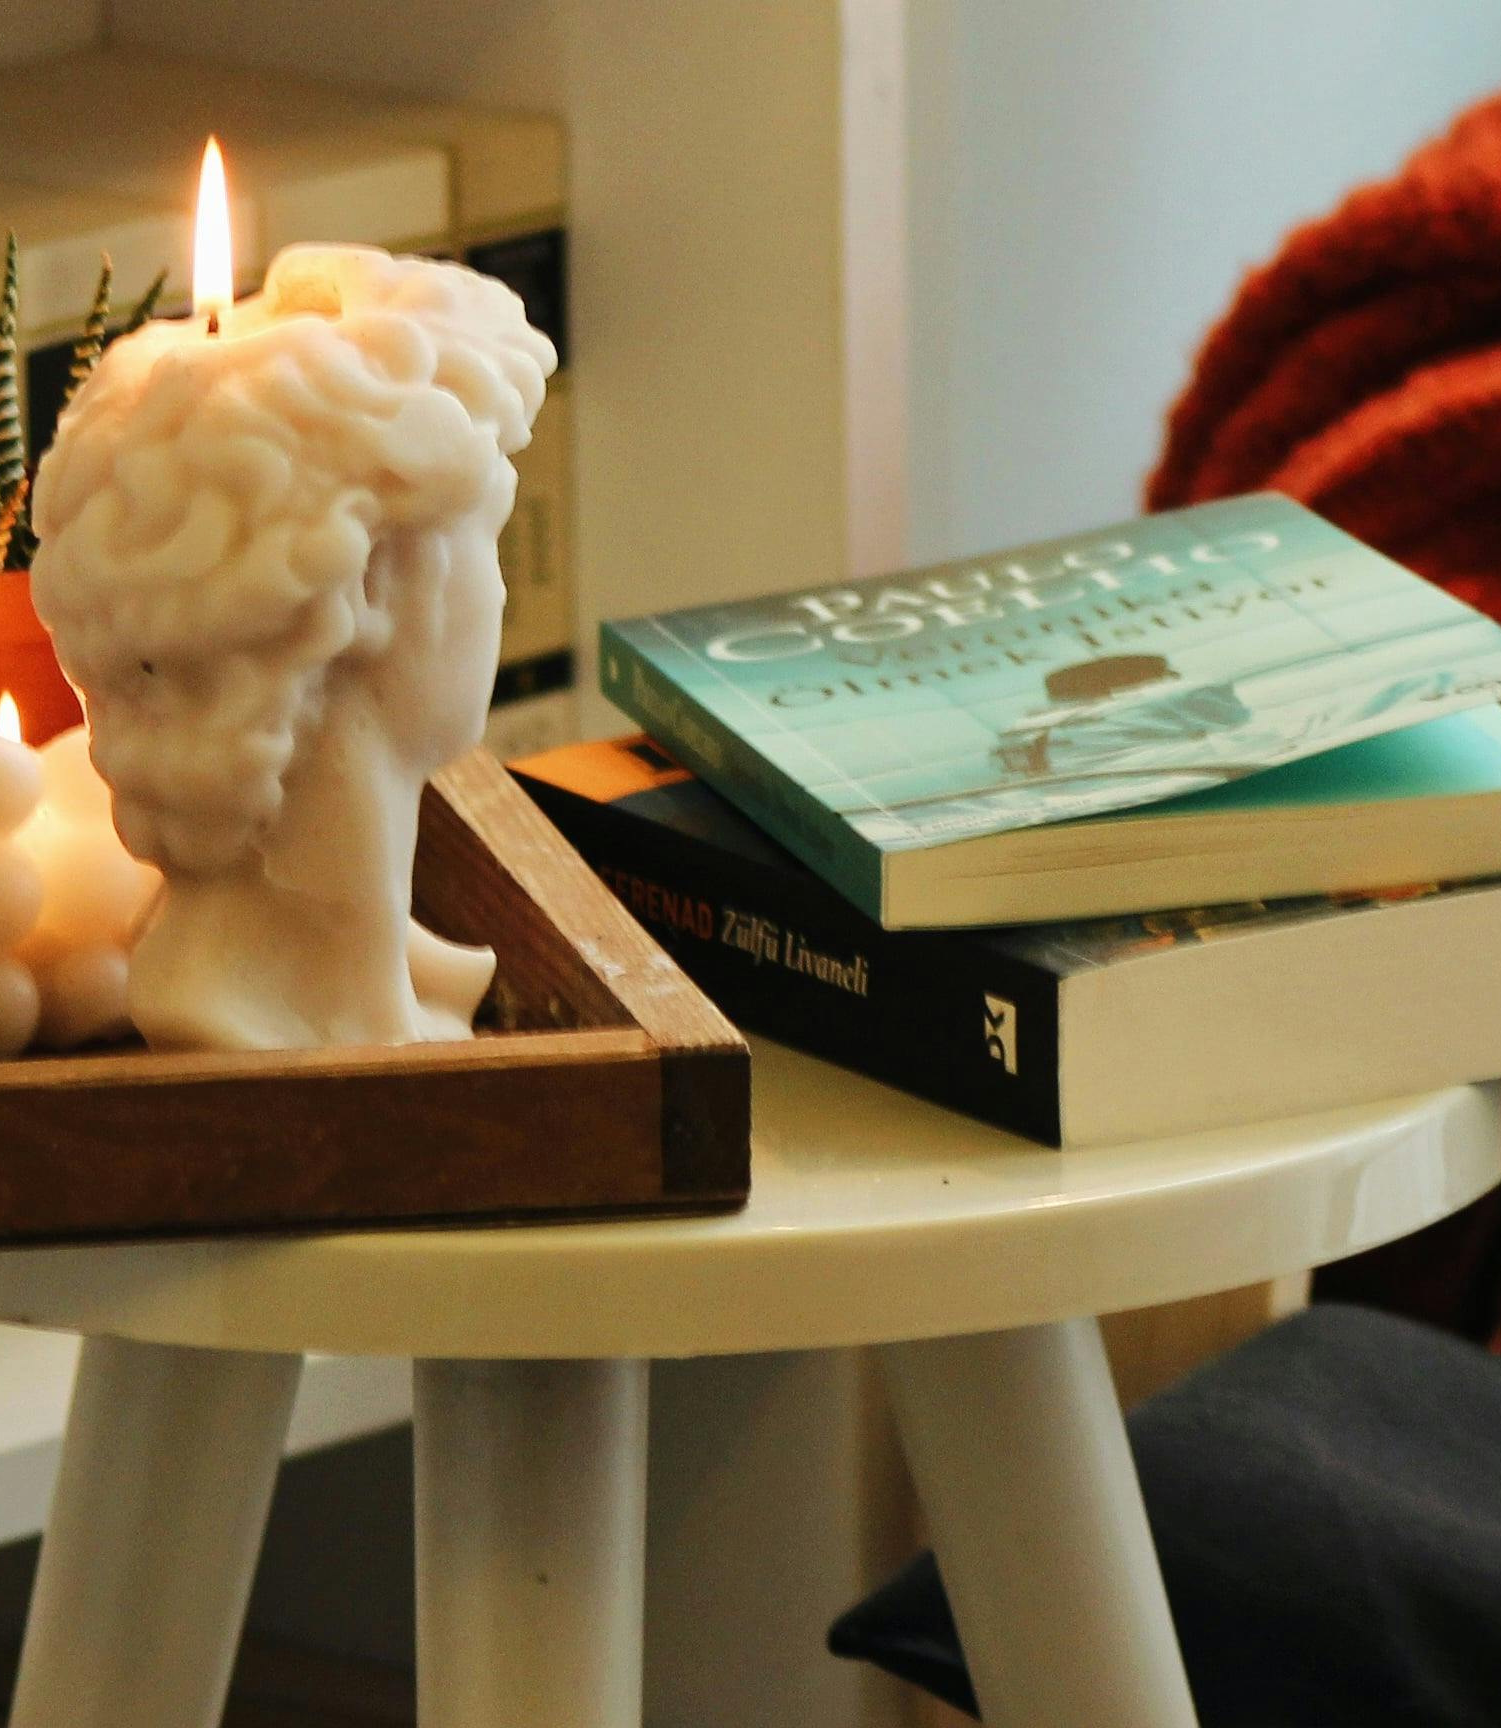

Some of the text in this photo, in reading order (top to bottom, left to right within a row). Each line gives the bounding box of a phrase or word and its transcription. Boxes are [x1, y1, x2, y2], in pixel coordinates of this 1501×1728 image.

[703, 530, 1282, 664] COELHO
[796, 540, 1137, 624] PAULO
[721, 908, 778, 966] Zülfü
[785, 929, 868, 996] Livaneli
